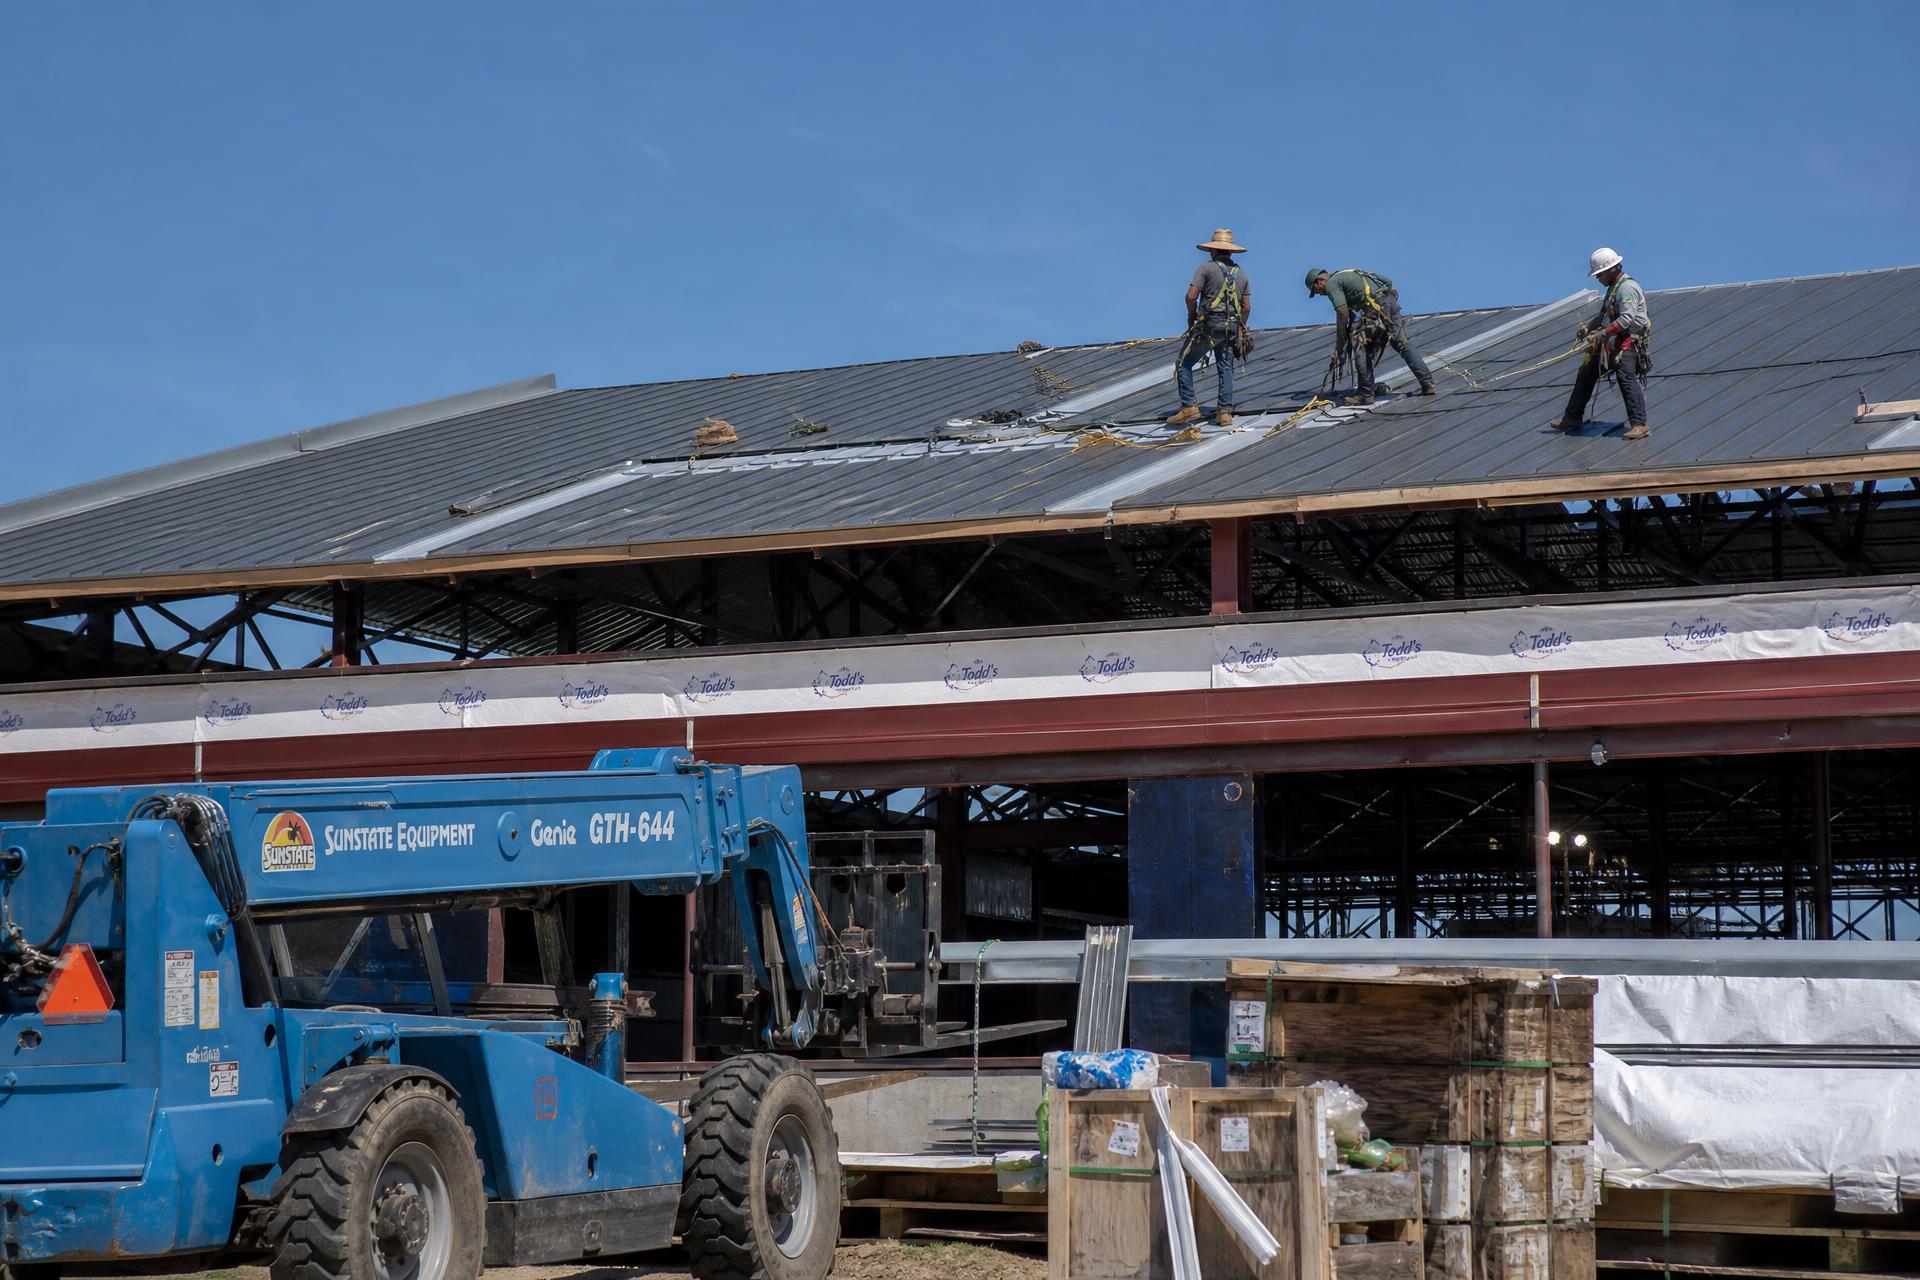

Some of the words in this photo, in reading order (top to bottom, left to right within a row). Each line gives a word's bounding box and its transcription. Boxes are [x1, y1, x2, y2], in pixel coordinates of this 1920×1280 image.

[1846, 613, 1892, 632] Todd's
[1684, 623, 1728, 640] Todd's
[1382, 640, 1422, 657] Todd's
[1530, 632, 1572, 650] Todd's
[1240, 648, 1279, 664] Todd's
[962, 665, 997, 681] Todd's
[1097, 657, 1134, 673] Todd's
[701, 678, 735, 694] Todd's
[830, 672, 864, 688] Todd's
[453, 691, 487, 707] Todd's
[575, 685, 608, 700] Todd's
[220, 702, 252, 718] Todd's
[336, 696, 368, 711] Todd's
[105, 708, 136, 724] Todd's
[530, 818, 577, 847] Genie
[589, 810, 675, 845] GTH-644
[324, 825, 393, 856] SUNSTATE
[397, 822, 476, 852] EQUIPMENT
[263, 843, 314, 871] SUNSTATE
